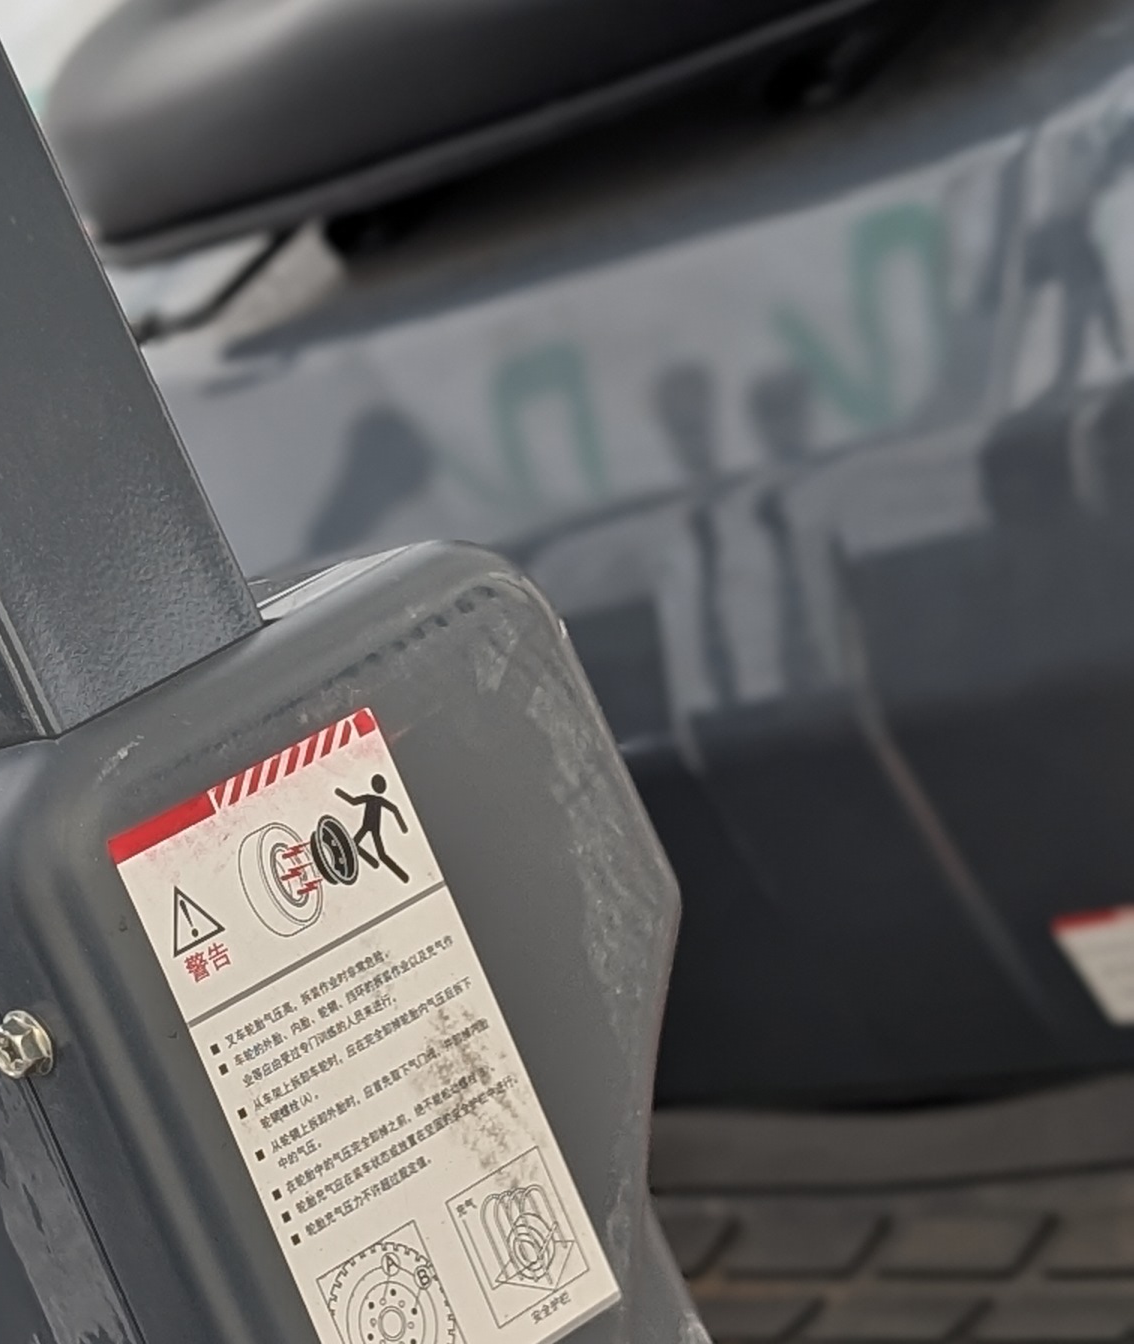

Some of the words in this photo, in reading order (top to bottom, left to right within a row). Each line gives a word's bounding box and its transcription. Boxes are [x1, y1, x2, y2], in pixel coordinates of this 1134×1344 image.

[183, 942, 232, 984] 警告
[454, 1195, 477, 1218] 充气
[384, 1254, 400, 1273] A
[416, 1268, 431, 1286] B
[530, 1289, 571, 1325] 安全护栏
